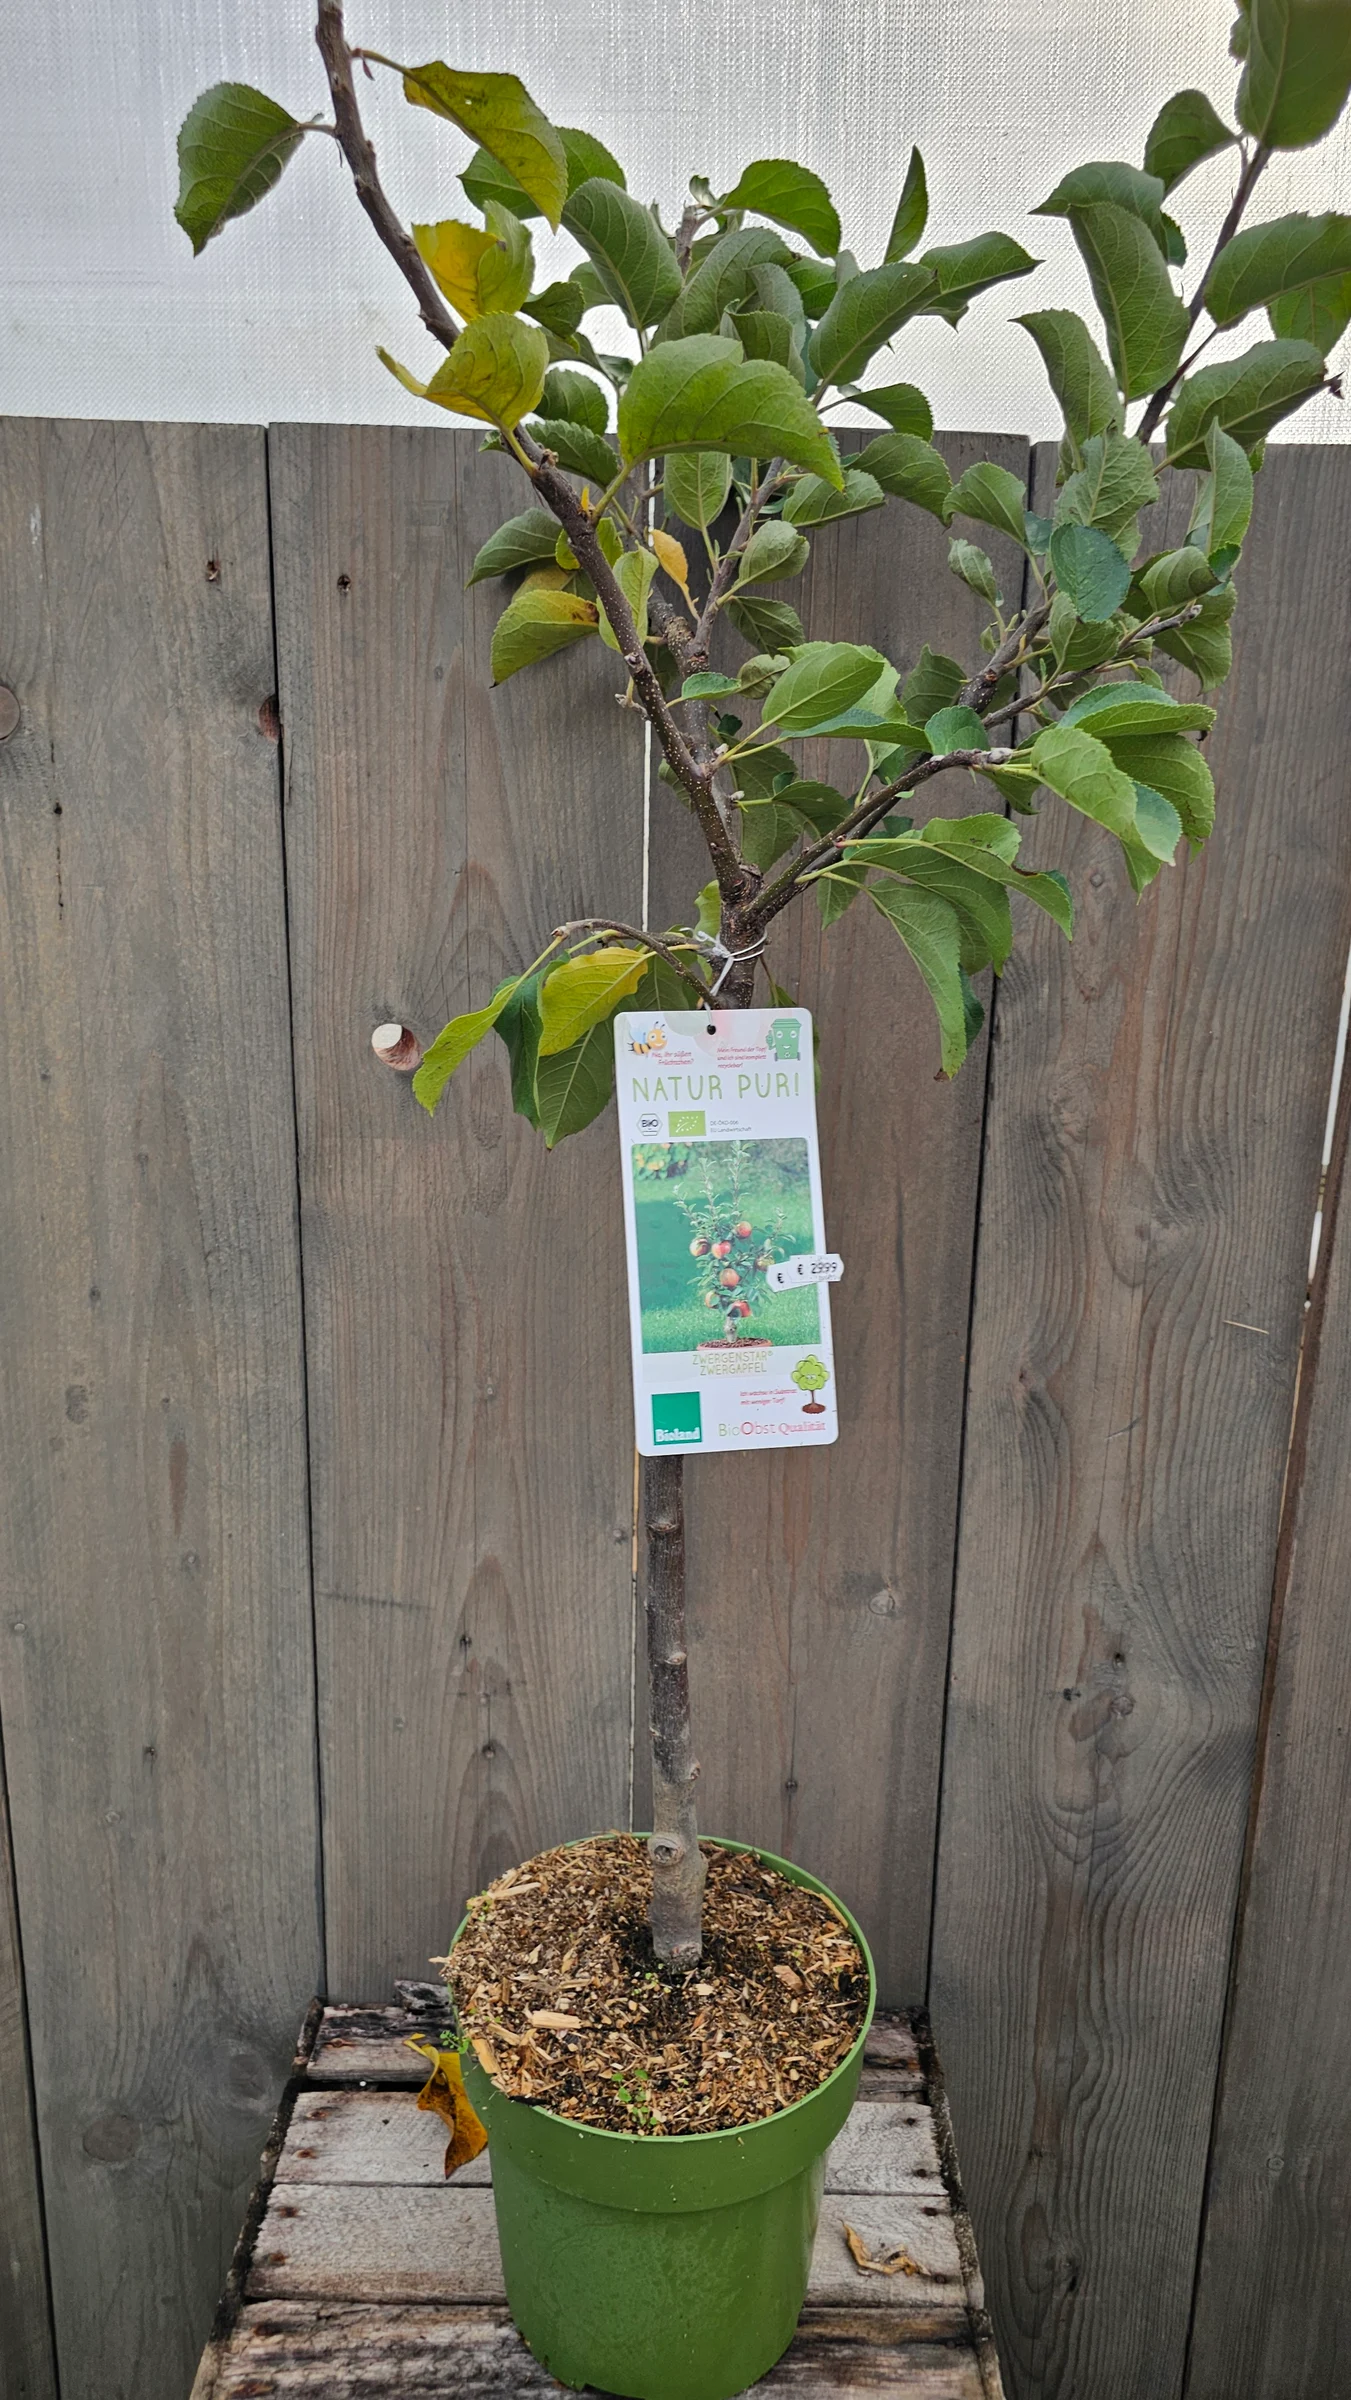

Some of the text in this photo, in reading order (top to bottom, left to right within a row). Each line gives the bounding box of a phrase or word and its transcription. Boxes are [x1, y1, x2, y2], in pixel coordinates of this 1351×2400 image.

[632, 1072, 800, 1102] NATUR PUR!
[655, 1427, 700, 1442] Bioland
[778, 1420, 826, 1435] Qualität
